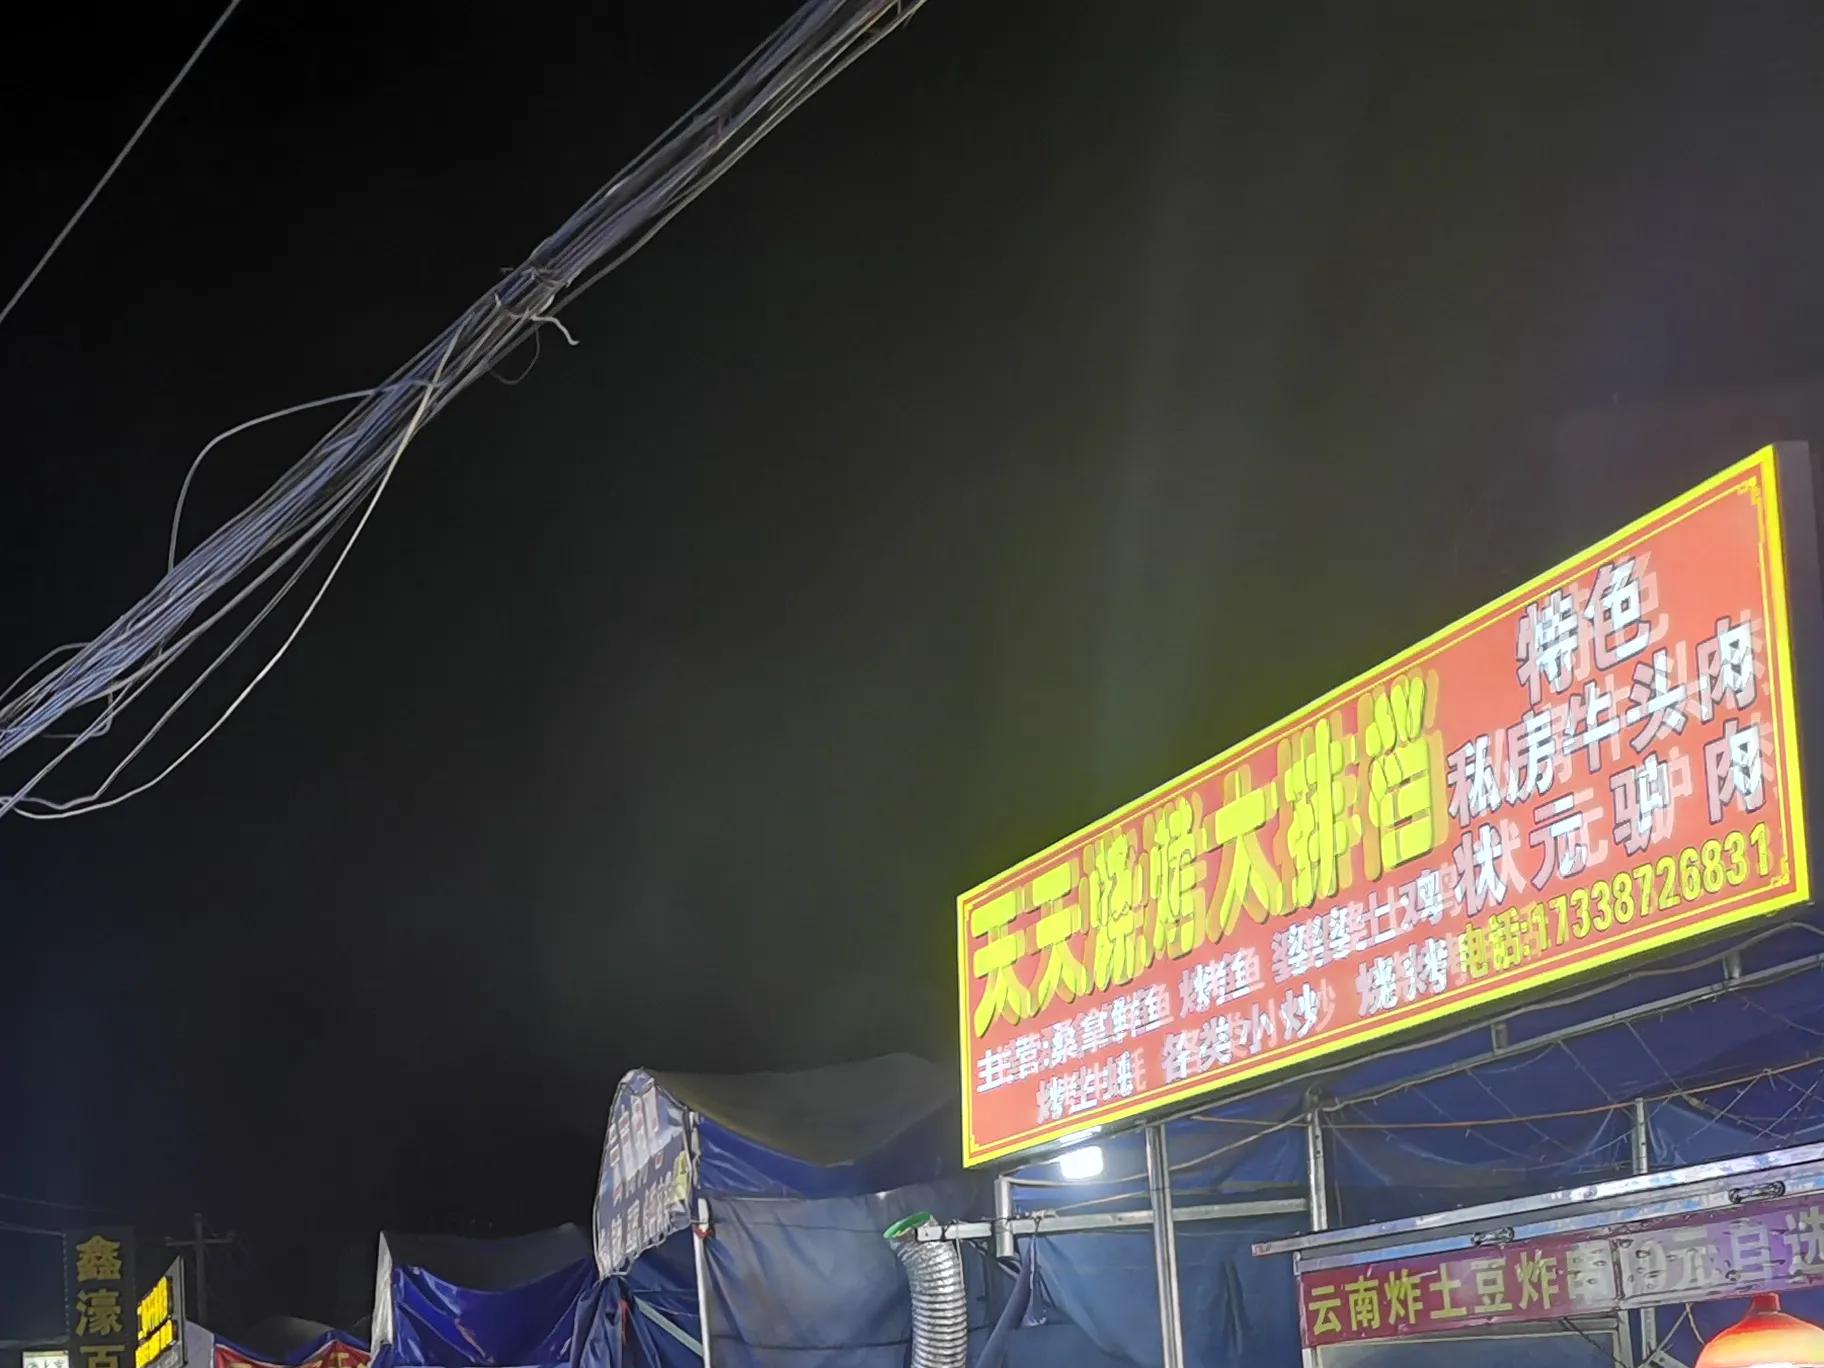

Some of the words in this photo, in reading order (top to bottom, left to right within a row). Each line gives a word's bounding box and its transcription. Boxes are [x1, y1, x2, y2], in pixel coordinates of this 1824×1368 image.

[1447, 616, 1762, 828] 私房牛头肉
[1516, 557, 1656, 706] 特色
[1453, 717, 1766, 918] 状元驴肉
